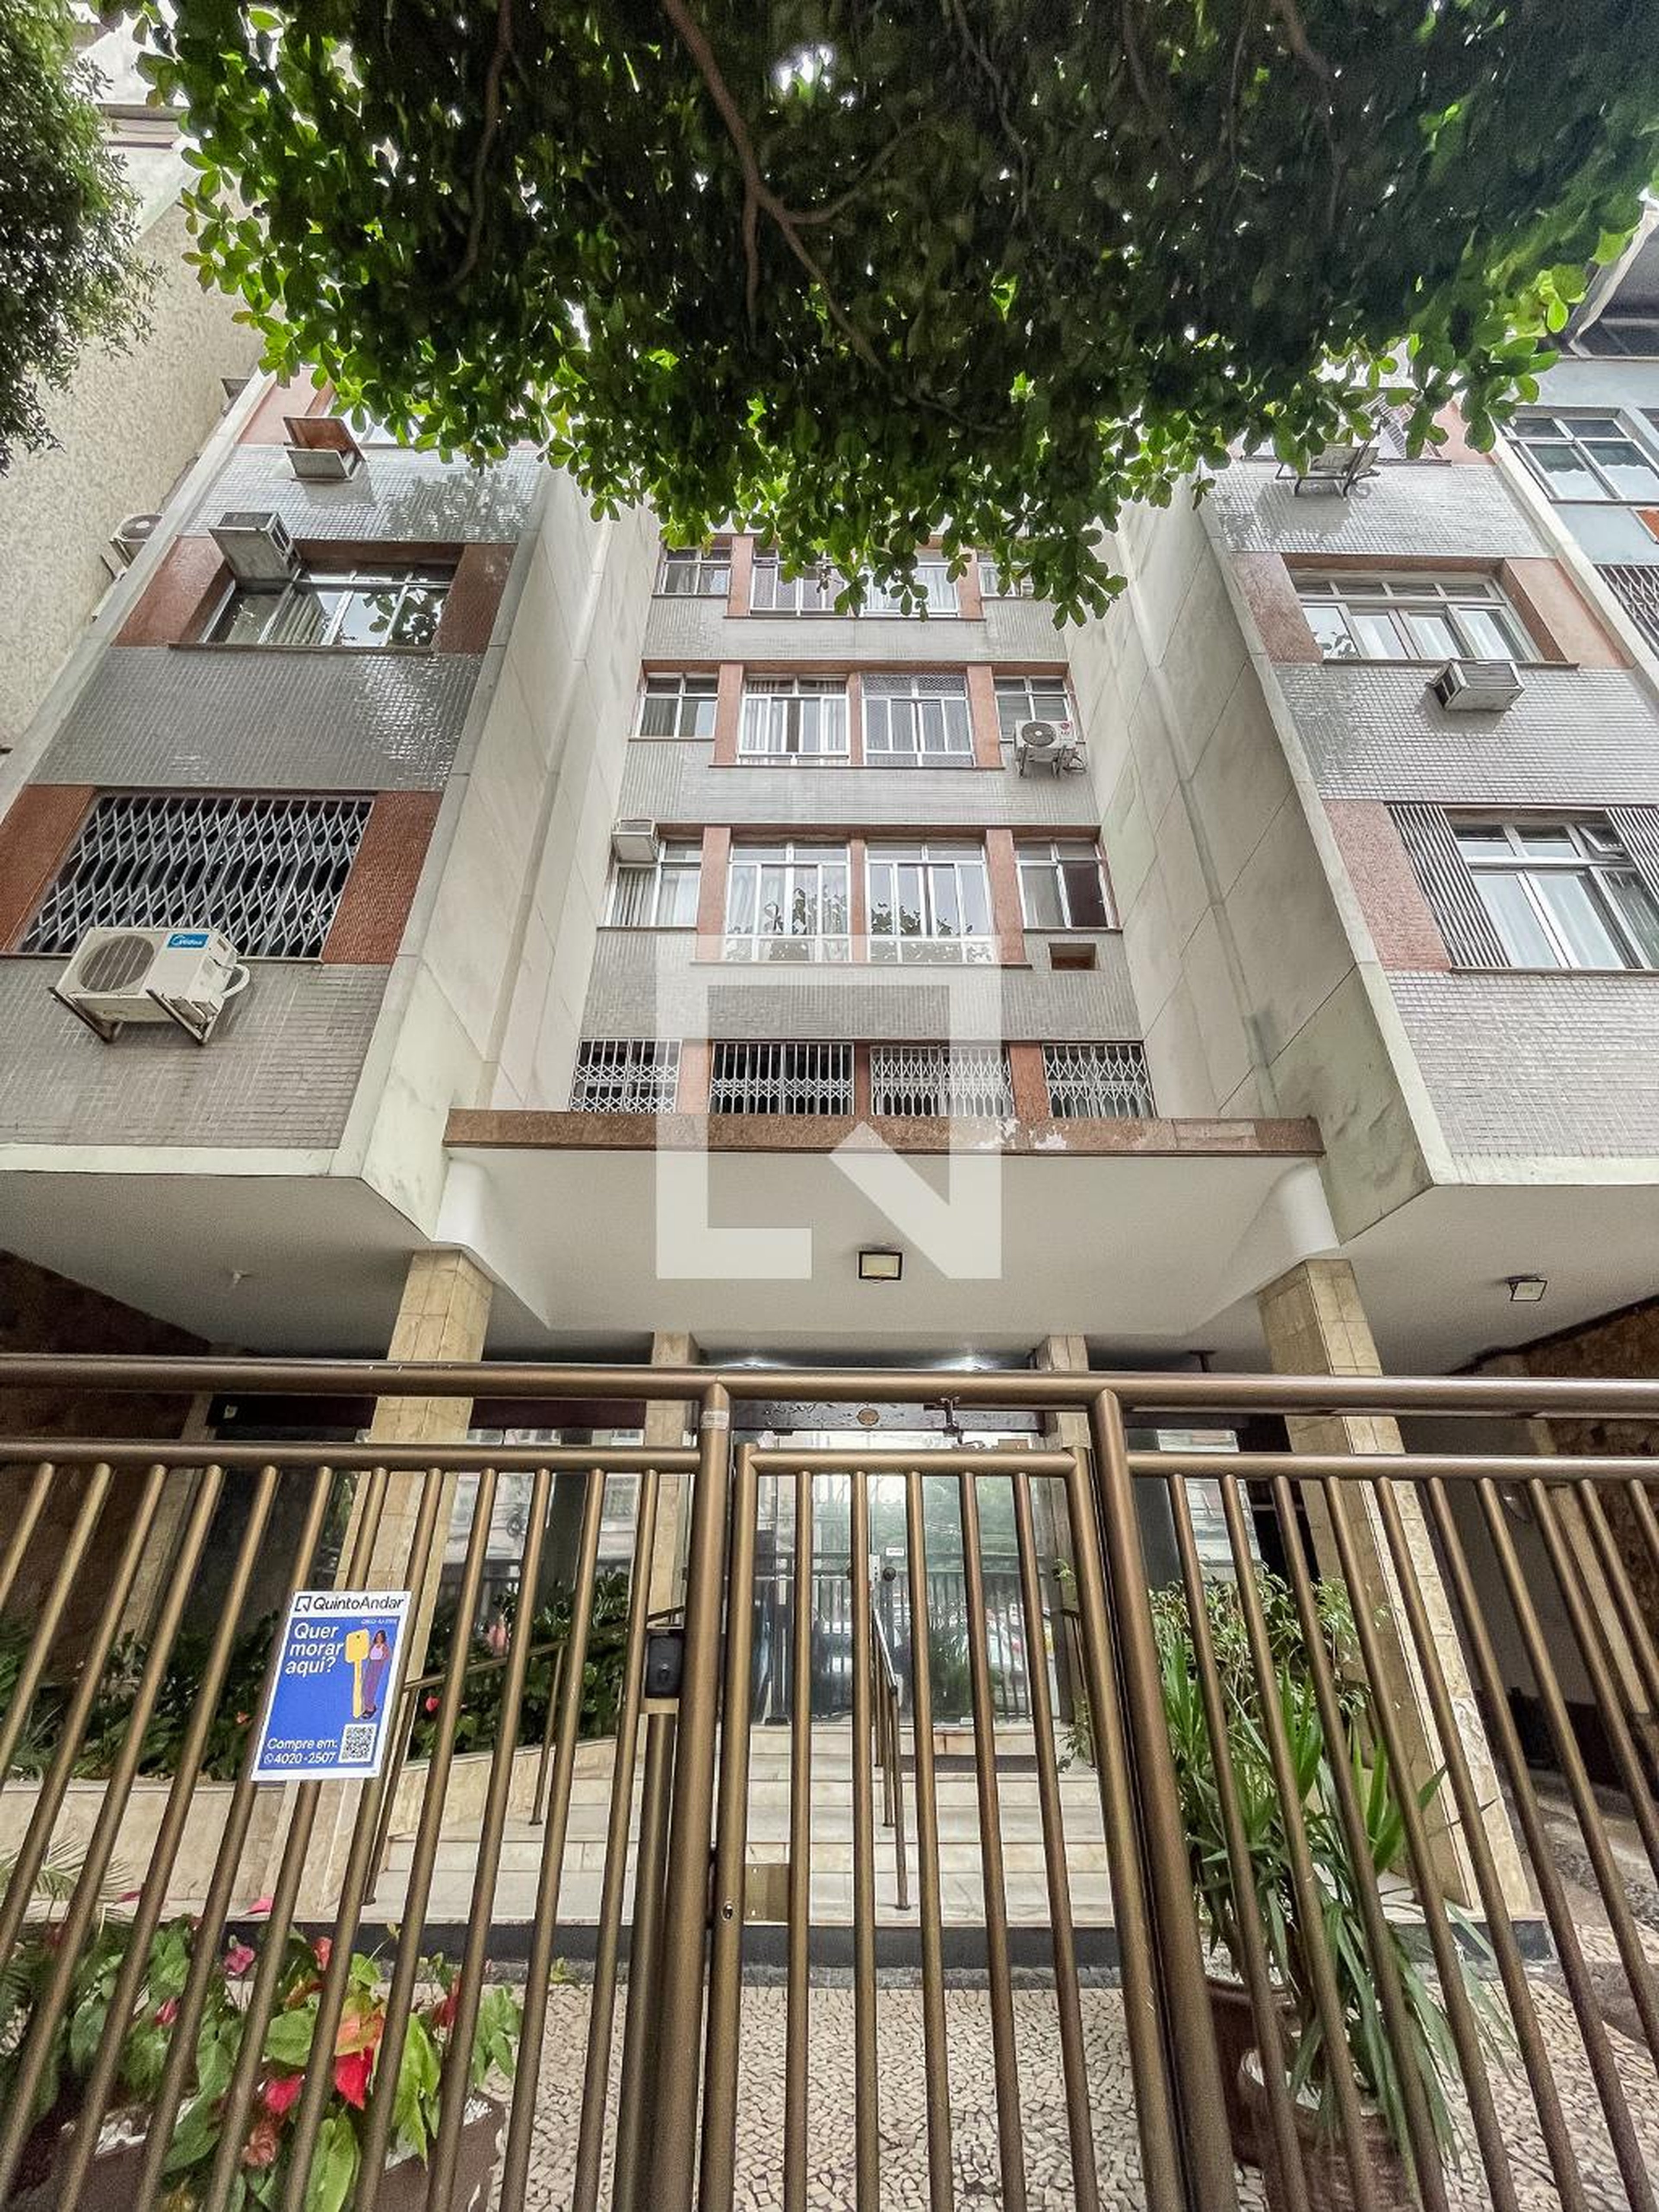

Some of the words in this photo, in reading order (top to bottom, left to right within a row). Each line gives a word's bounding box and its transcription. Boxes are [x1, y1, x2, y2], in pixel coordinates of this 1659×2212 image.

[313, 1597, 404, 1610] QuintoAndar
[295, 1622, 339, 1639] Quer
[290, 1643, 344, 1656] morar
[285, 1656, 336, 1677] aqui?
[267, 1738, 314, 1751] Compre
[317, 1739, 338, 1749] em:
[274, 1752, 336, 1764] 4020-2507
